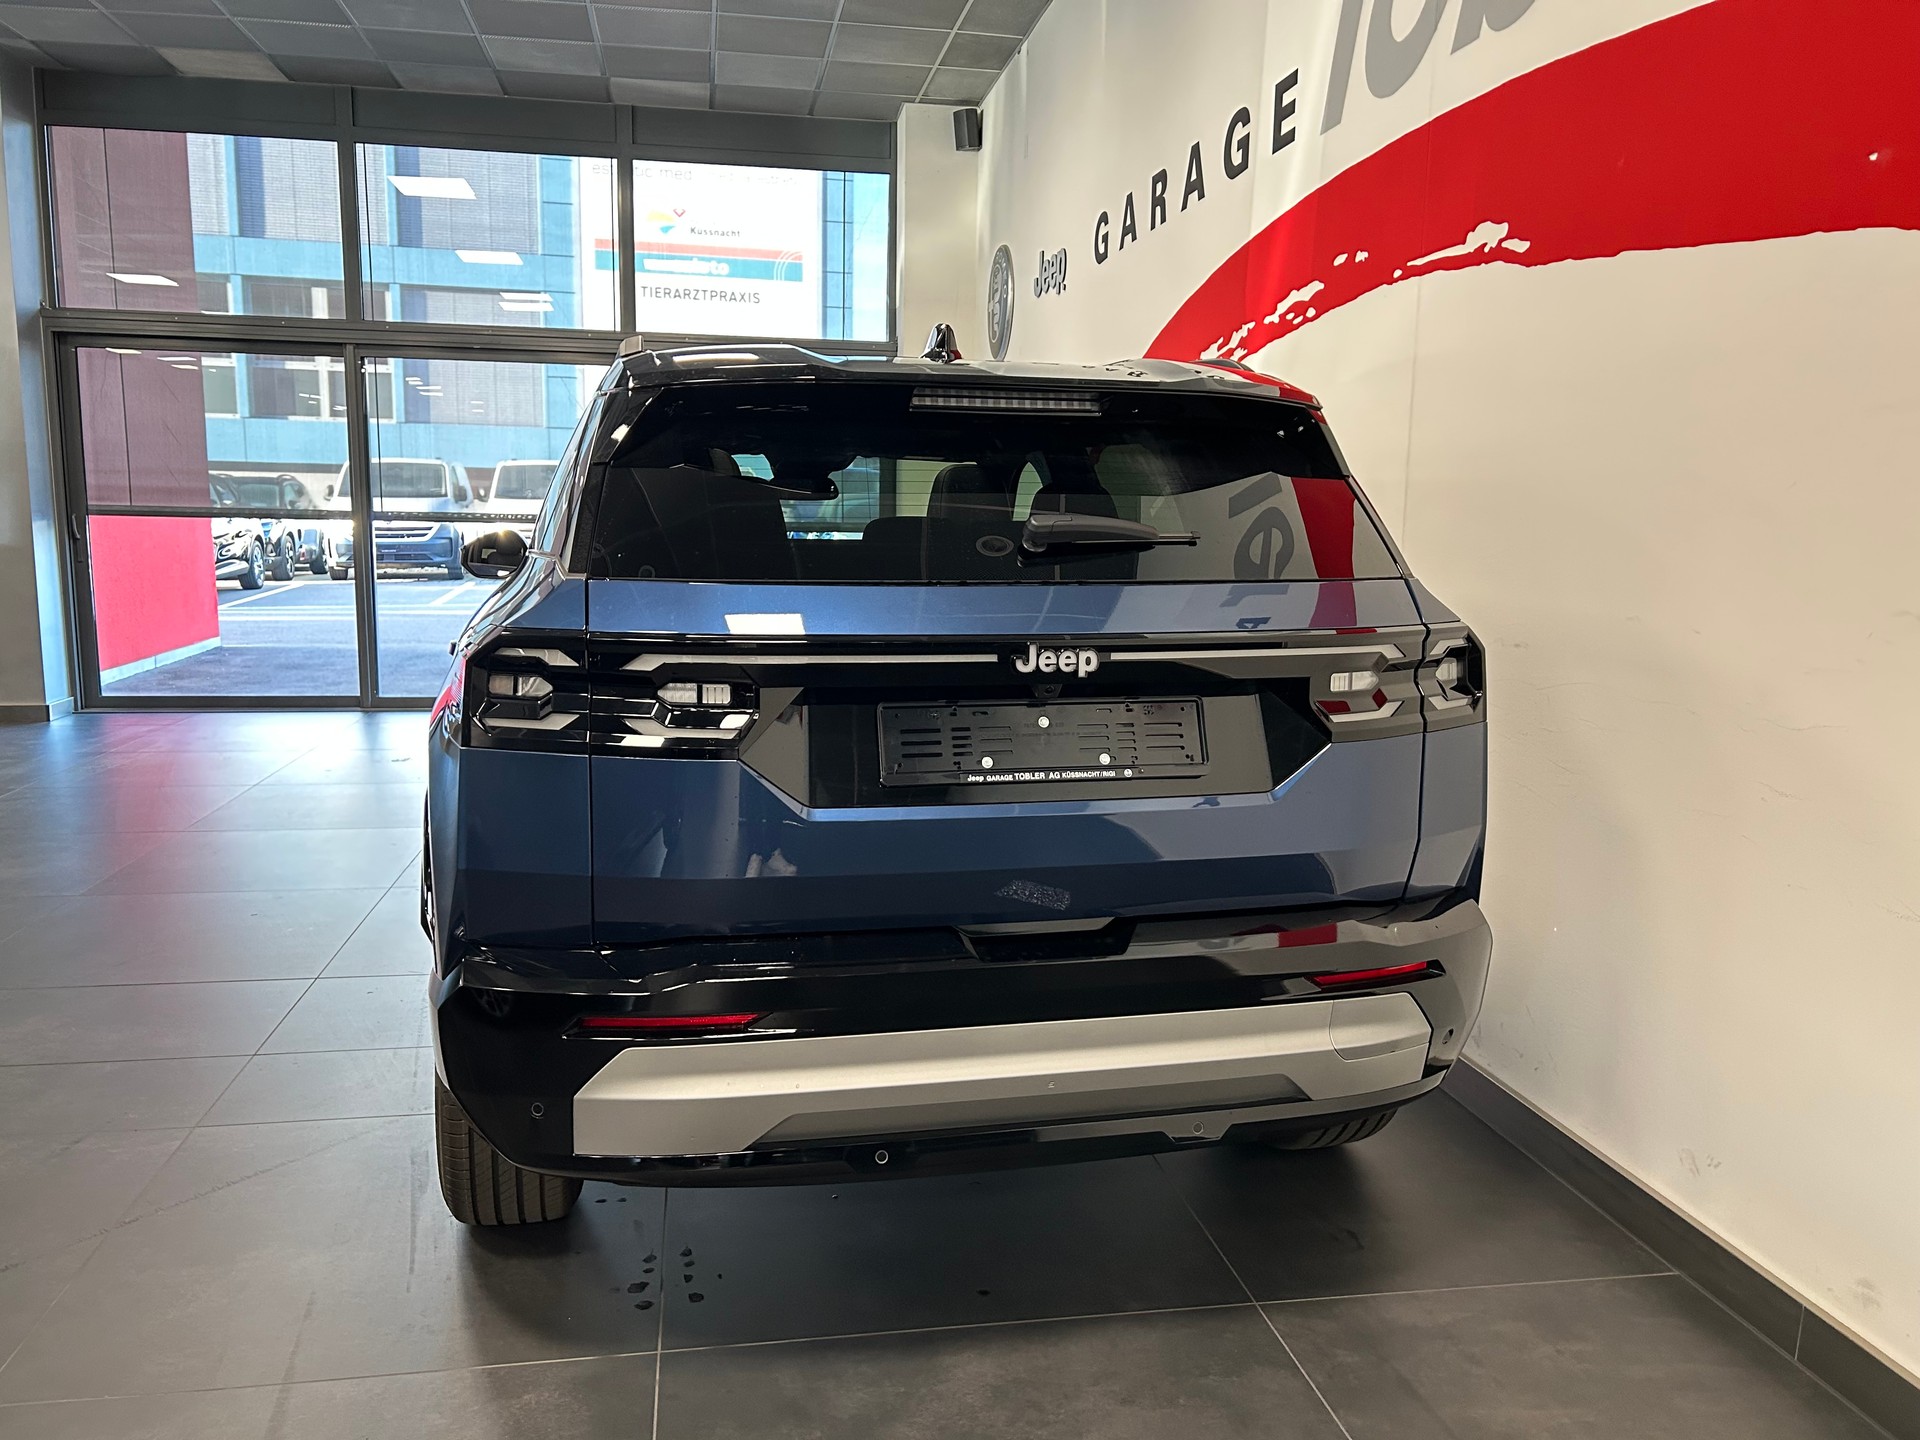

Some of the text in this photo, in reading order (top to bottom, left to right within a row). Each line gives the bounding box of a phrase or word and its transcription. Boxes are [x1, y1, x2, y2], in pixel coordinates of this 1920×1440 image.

[1094, 68, 1299, 265] GARAGE
[1033, 247, 1067, 298] Jeep
[641, 286, 761, 304] TIERARZTPRAXIS
[1013, 641, 1099, 678] Jeep
[967, 774, 984, 783] Jeep
[986, 773, 1014, 782] GARAGE
[1014, 771, 1046, 781] TOBLER
[1049, 771, 1061, 780] AG
